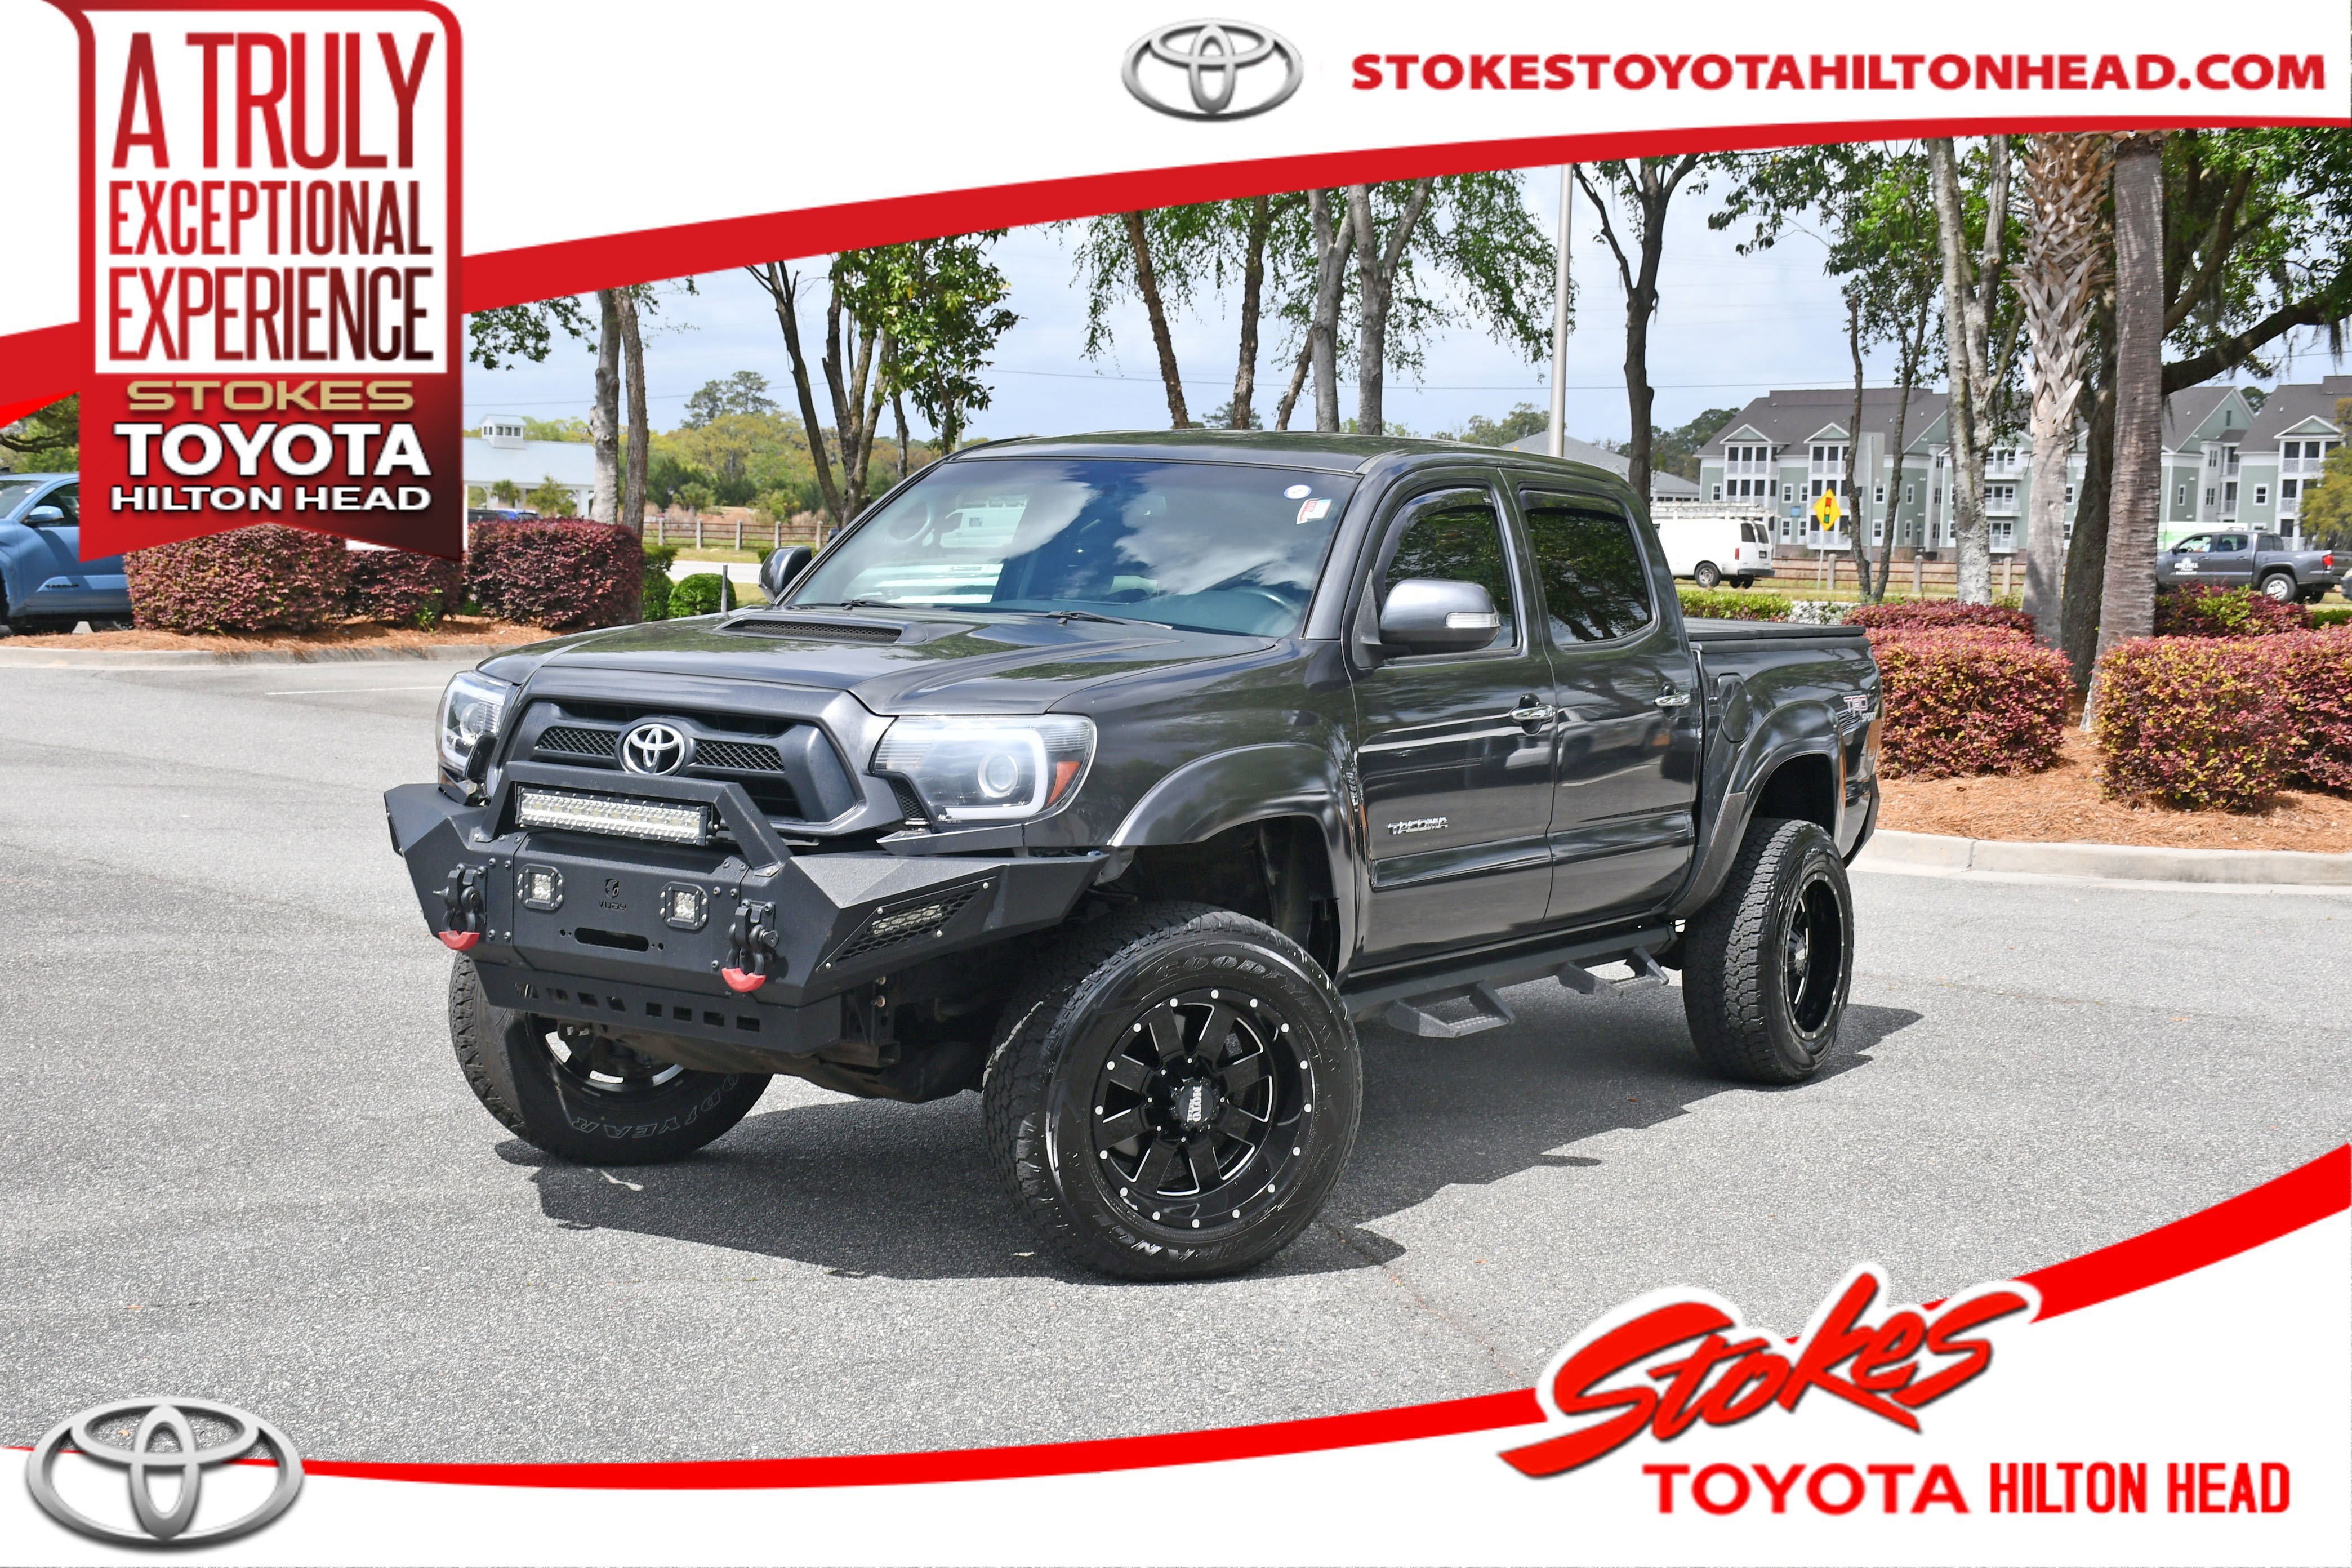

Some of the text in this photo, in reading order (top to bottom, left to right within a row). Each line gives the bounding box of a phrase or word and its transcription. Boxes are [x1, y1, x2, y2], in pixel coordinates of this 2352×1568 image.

[1843, 694, 1868, 717] TRD
[1387, 817, 1448, 835] TACOMA
[1193, 1085, 1202, 1122] MOTO
